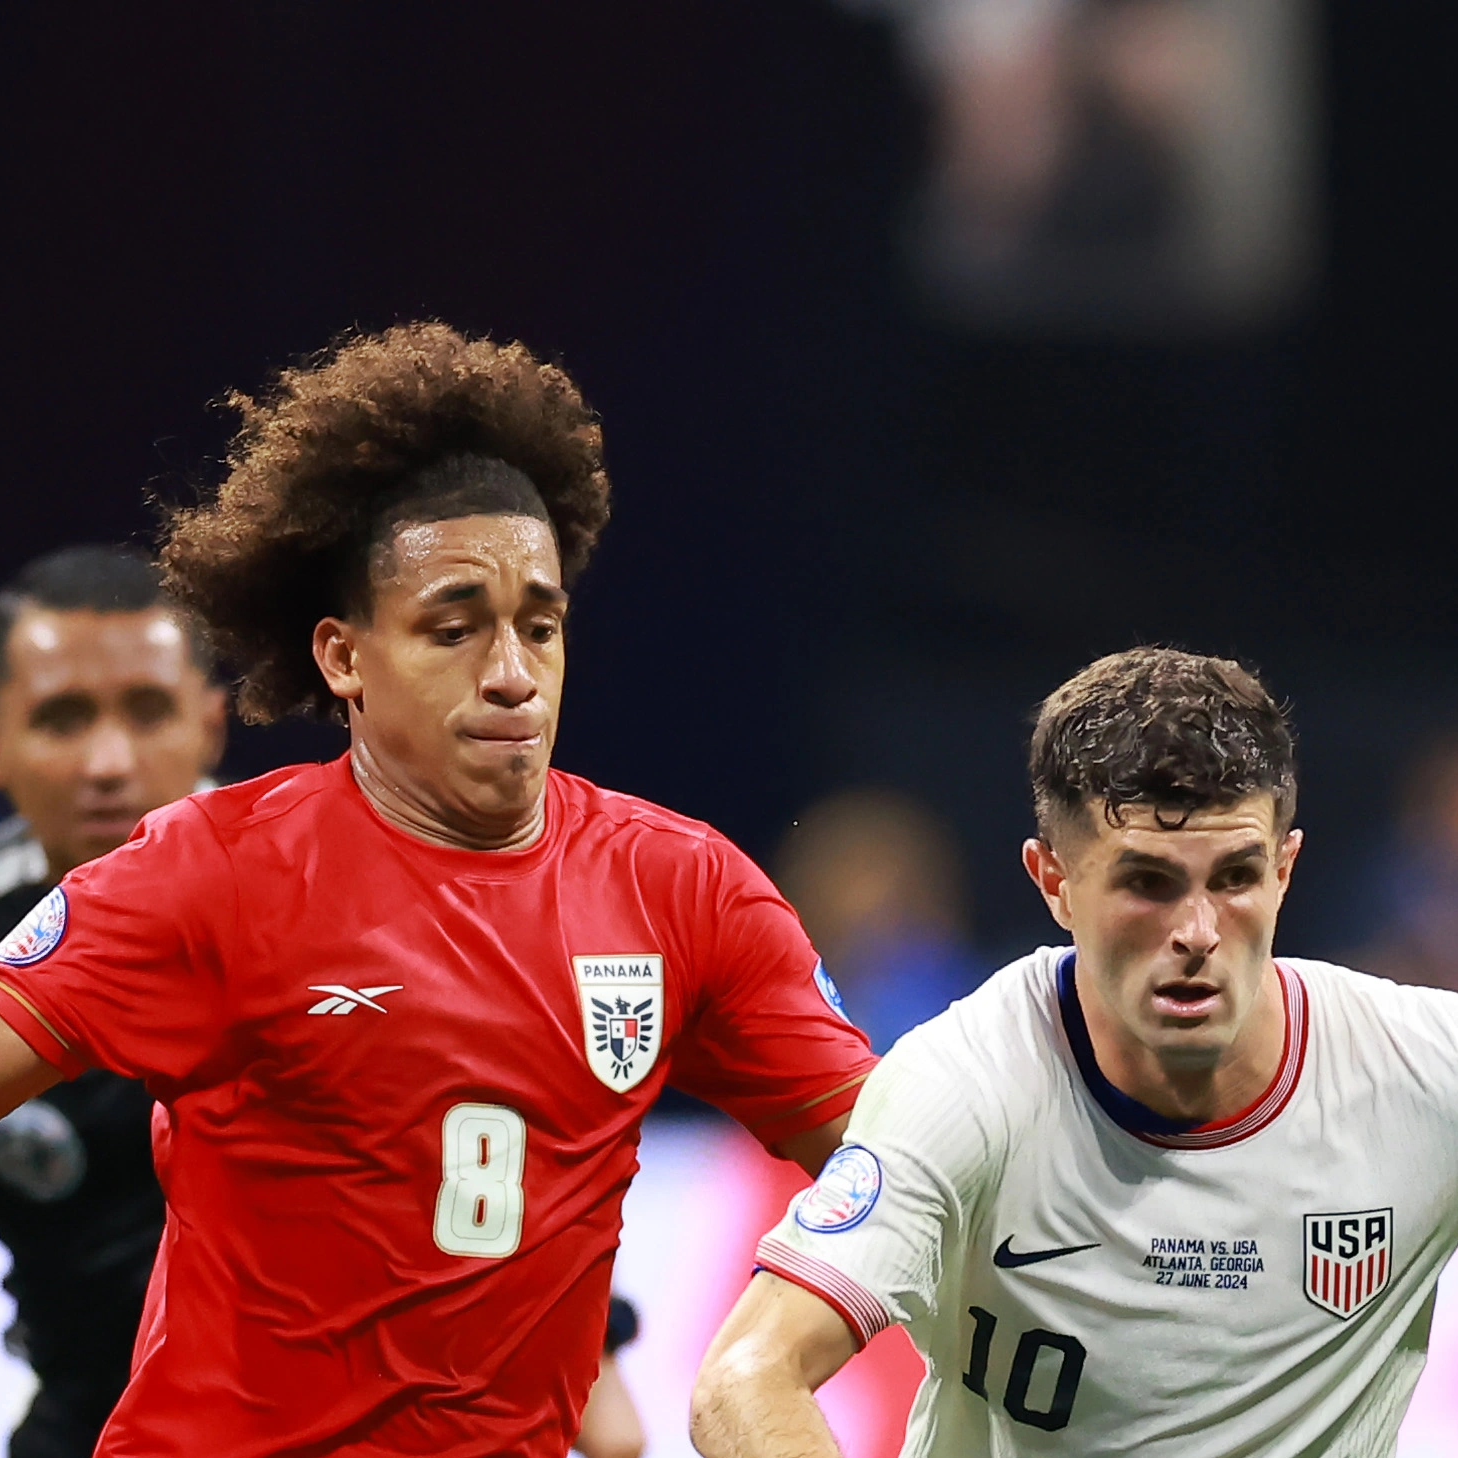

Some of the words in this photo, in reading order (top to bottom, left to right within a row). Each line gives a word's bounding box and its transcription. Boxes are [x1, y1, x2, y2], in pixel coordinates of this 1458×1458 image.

[583, 961, 653, 978] PANAMÁ
[433, 1102, 526, 1258] 8
[1150, 1238, 1205, 1254] PANAMA
[1210, 1241, 1230, 1255] VS.
[1233, 1240, 1258, 1255] USA
[1311, 1216, 1386, 1259] USA
[1142, 1255, 1207, 1272] ATLANTA,
[1210, 1257, 1264, 1272] GEORGIA
[1155, 1271, 1174, 1285] 27
[1177, 1273, 1211, 1288] JUNE
[1214, 1274, 1248, 1290] 2024
[962, 1305, 1087, 1432] 10
